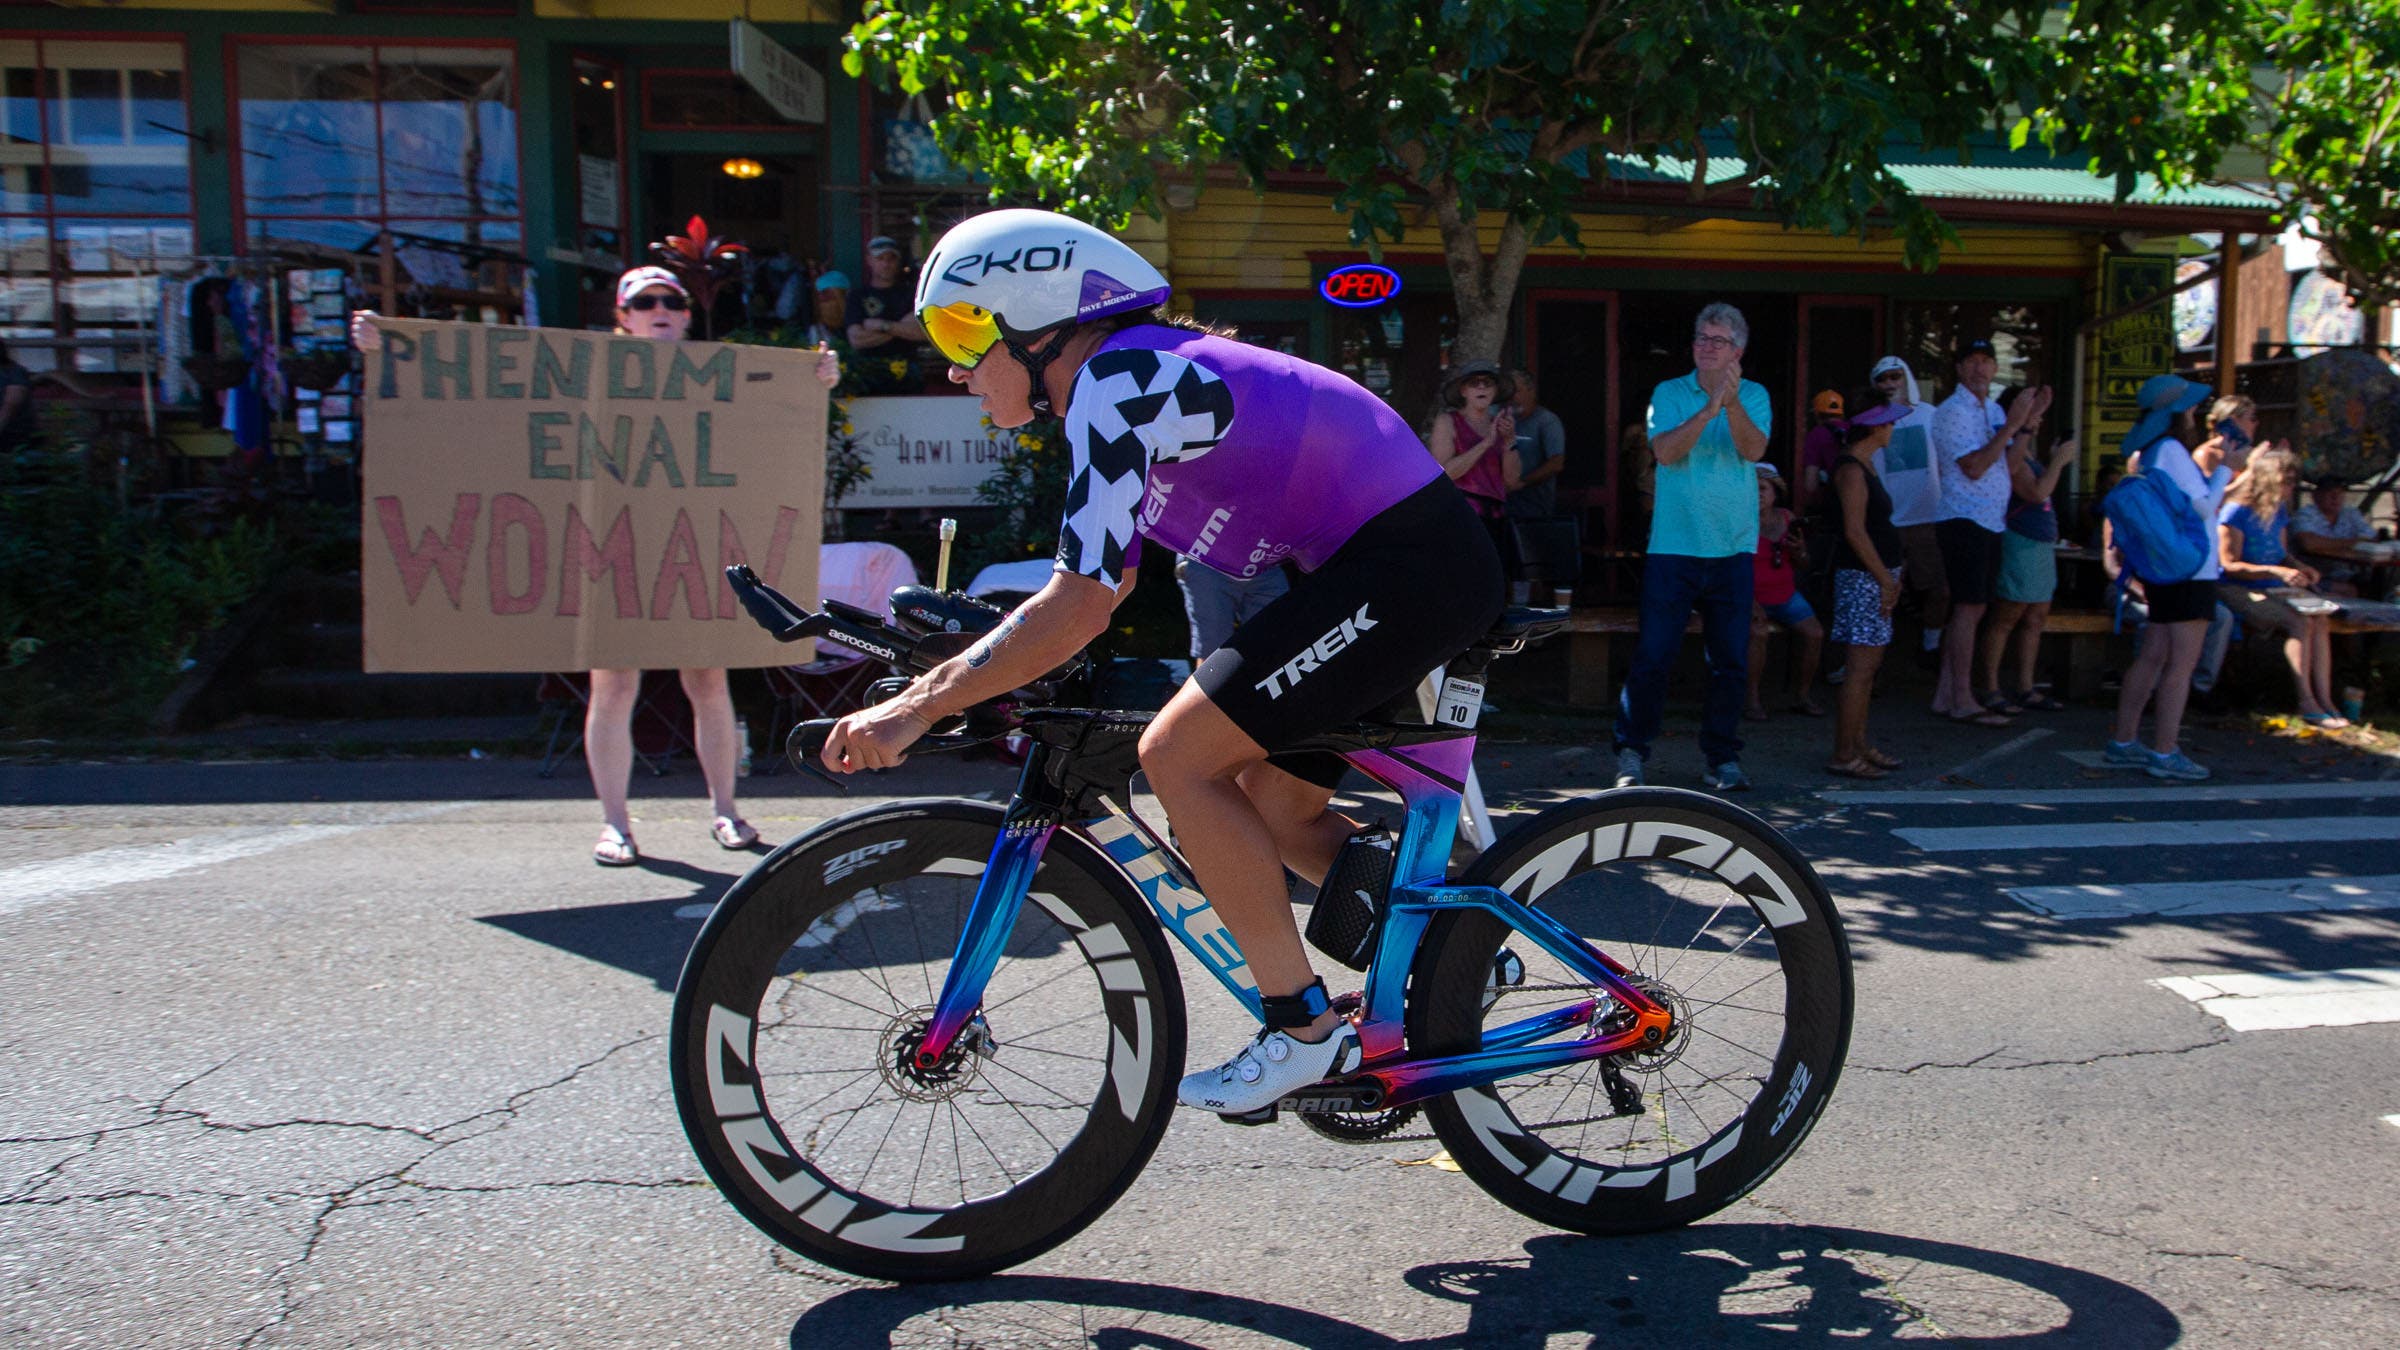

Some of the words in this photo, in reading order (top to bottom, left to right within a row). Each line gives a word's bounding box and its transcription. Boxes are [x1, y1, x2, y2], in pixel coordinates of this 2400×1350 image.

[1326, 273, 1393, 297] OPEN
[1080, 302, 1102, 313] SKYE
[1103, 292, 1137, 307] MOENCH
[379, 328, 772, 401] PHENOM-
[528, 411, 737, 488] ENAL
[898, 433, 951, 464] HAWI
[963, 438, 1019, 464] TURN
[1136, 474, 1174, 534] REK
[375, 493, 798, 620] WOMAN
[828, 628, 896, 660] aerocoach
[1255, 602, 1379, 700] TREK
[1105, 724, 1145, 732] PROJE
[1450, 704, 1468, 722] 10
[1006, 827, 1048, 838] CNCPT
[1008, 819, 1050, 829] SPEED
[823, 839, 908, 876] ZIPP
[1279, 1097, 1352, 1112] RAM
[1770, 1067, 1813, 1136] ZIPP
